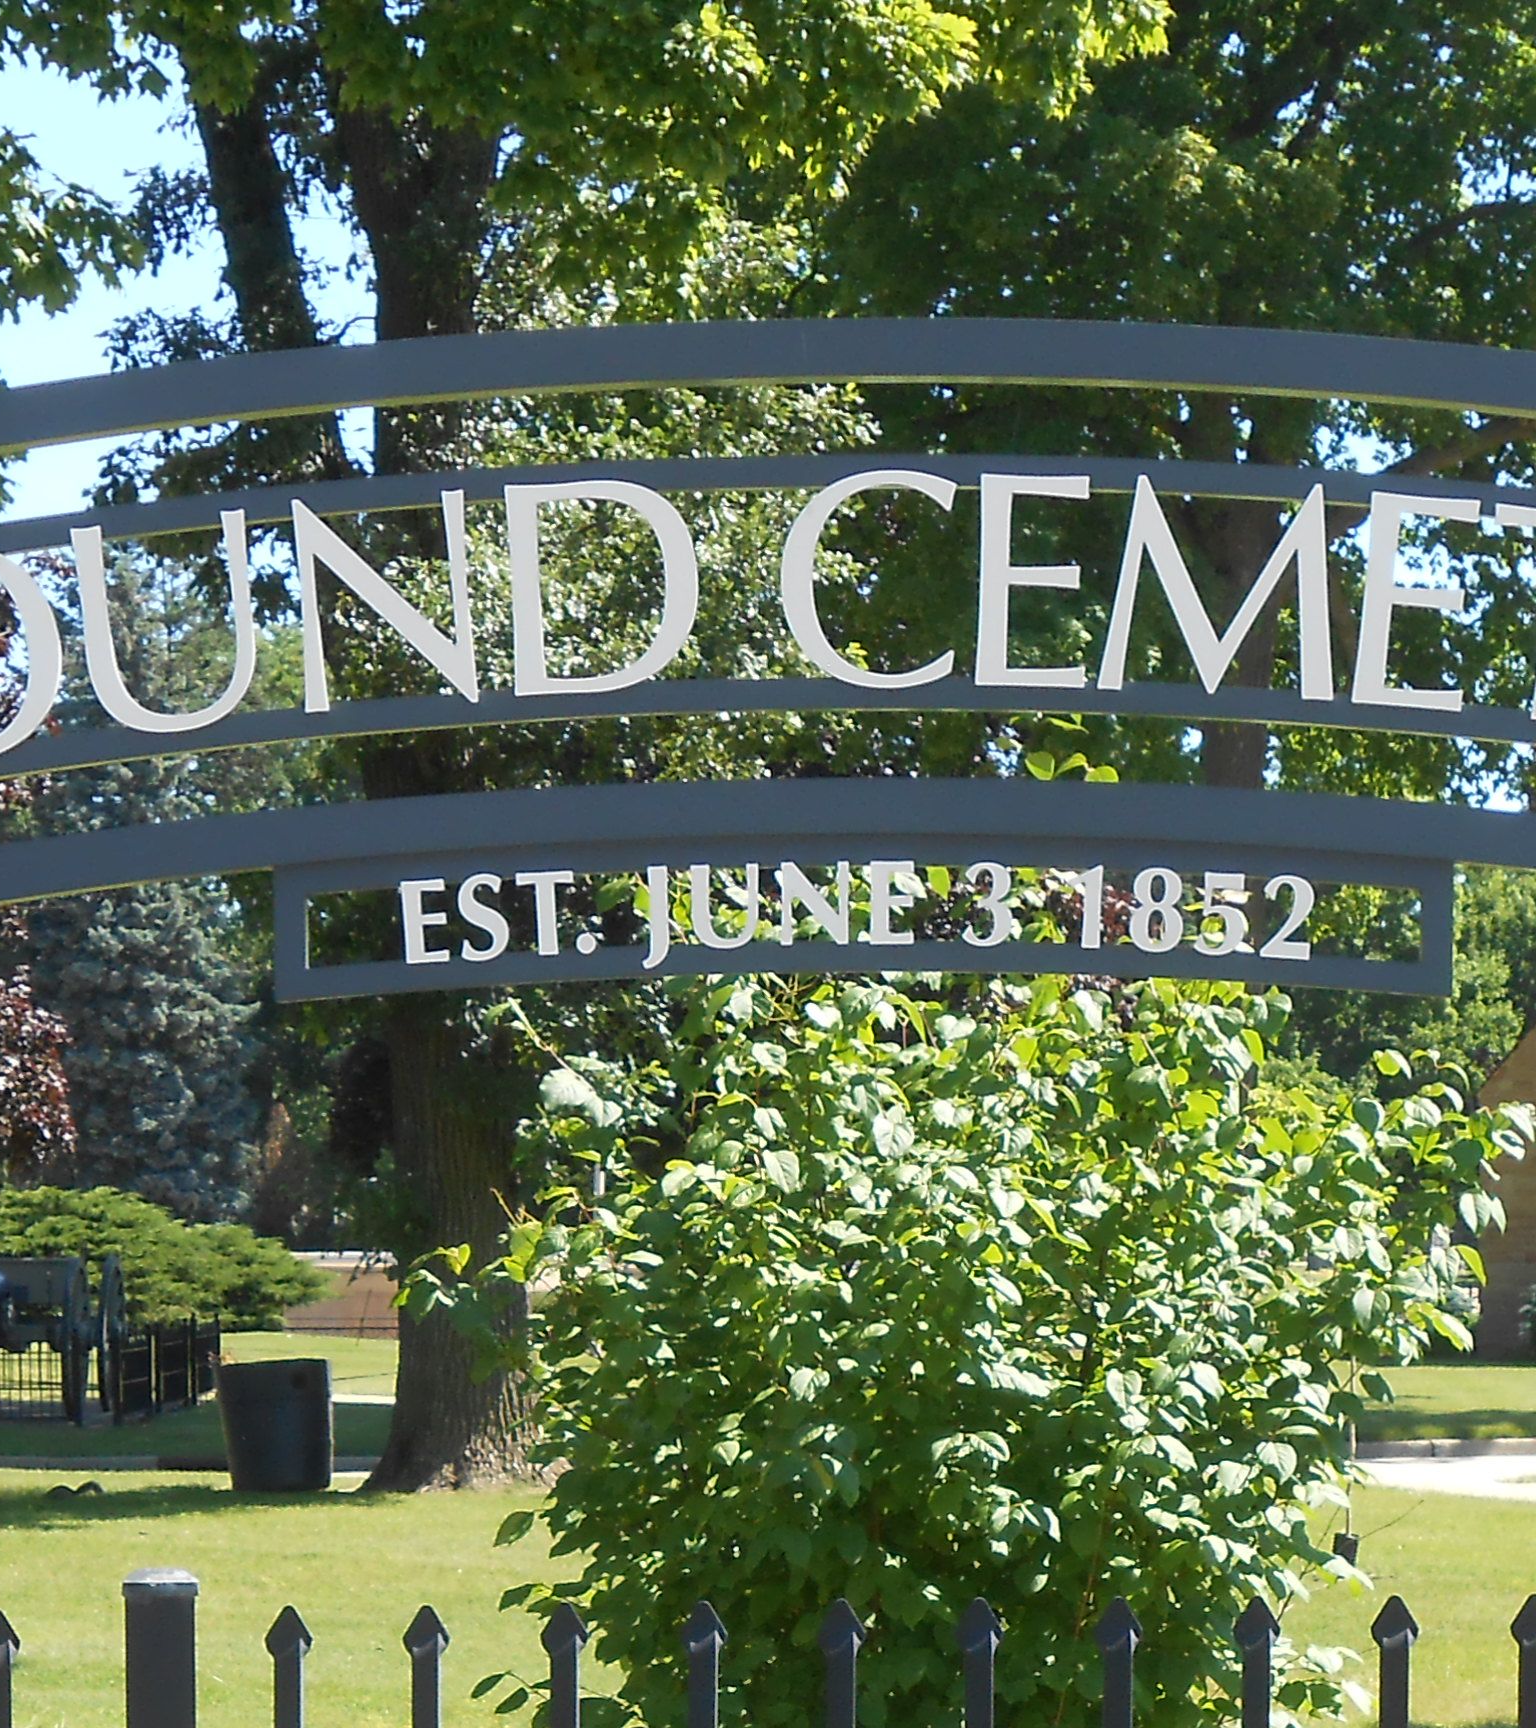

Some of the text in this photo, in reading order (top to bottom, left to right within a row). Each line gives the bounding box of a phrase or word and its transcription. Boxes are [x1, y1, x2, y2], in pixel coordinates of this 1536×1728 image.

[398, 859, 1316, 969] EST. JUNE 3 1852
